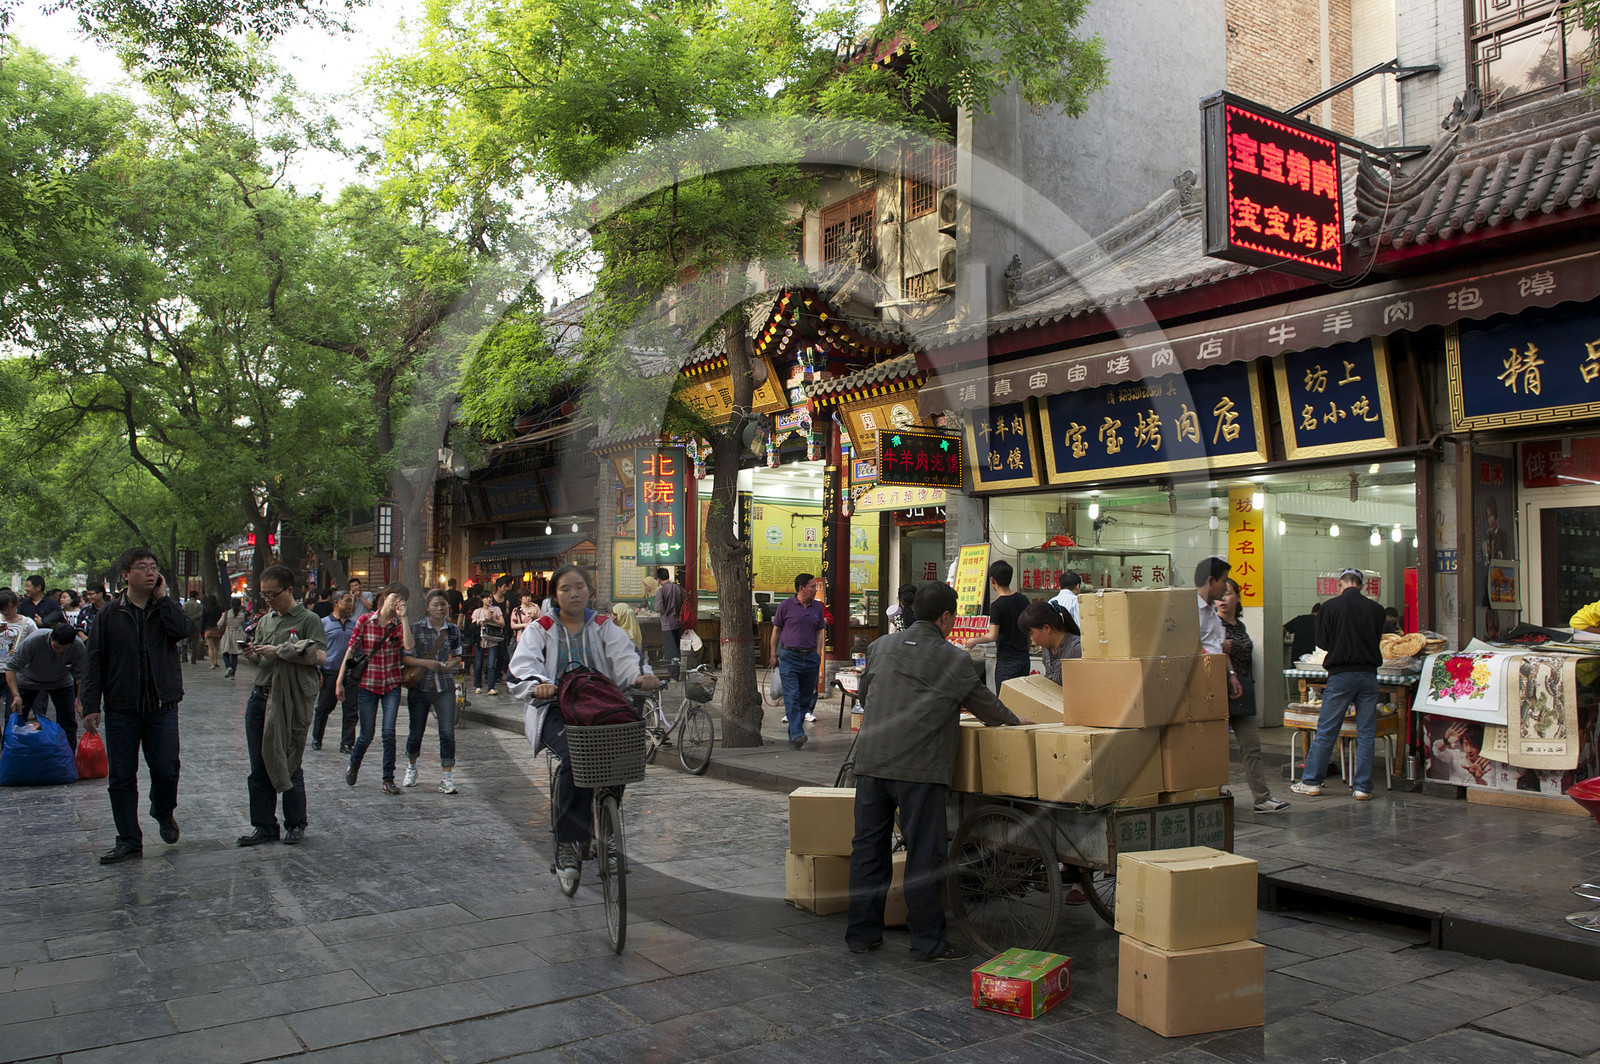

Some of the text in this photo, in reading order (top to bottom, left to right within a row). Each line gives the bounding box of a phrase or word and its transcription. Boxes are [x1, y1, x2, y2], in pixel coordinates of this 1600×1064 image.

[1232, 133, 1335, 199] 宝宝烤肉
[1234, 197, 1338, 251] 宝宝烤肉
[959, 271, 1556, 402] 清真宝宝烤肉店 牛羊肉泡馍
[1304, 360, 1362, 393] 坊上
[1497, 337, 1600, 396] 精品
[979, 413, 1025, 444] 牛羊肉
[1065, 396, 1241, 459] 宝宝烤肉店
[1300, 395, 1379, 431] 名小吃
[882, 447, 959, 475] 牛羊肉泡馍
[988, 449, 1025, 472] 泡馍
[1525, 448, 1600, 481] 俄罗斯
[642, 453, 675, 537] 北院门
[863, 487, 943, 506] 北院门招待所
[638, 542, 670, 557] 话吧
[1235, 498, 1256, 597] 坊上名小吃
[923, 562, 938, 581] 温
[1022, 568, 1062, 591] 麻酱凉皮
[1440, 559, 1458, 571] 115
[1120, 819, 1148, 842] 西安
[1160, 814, 1186, 836] 金元
